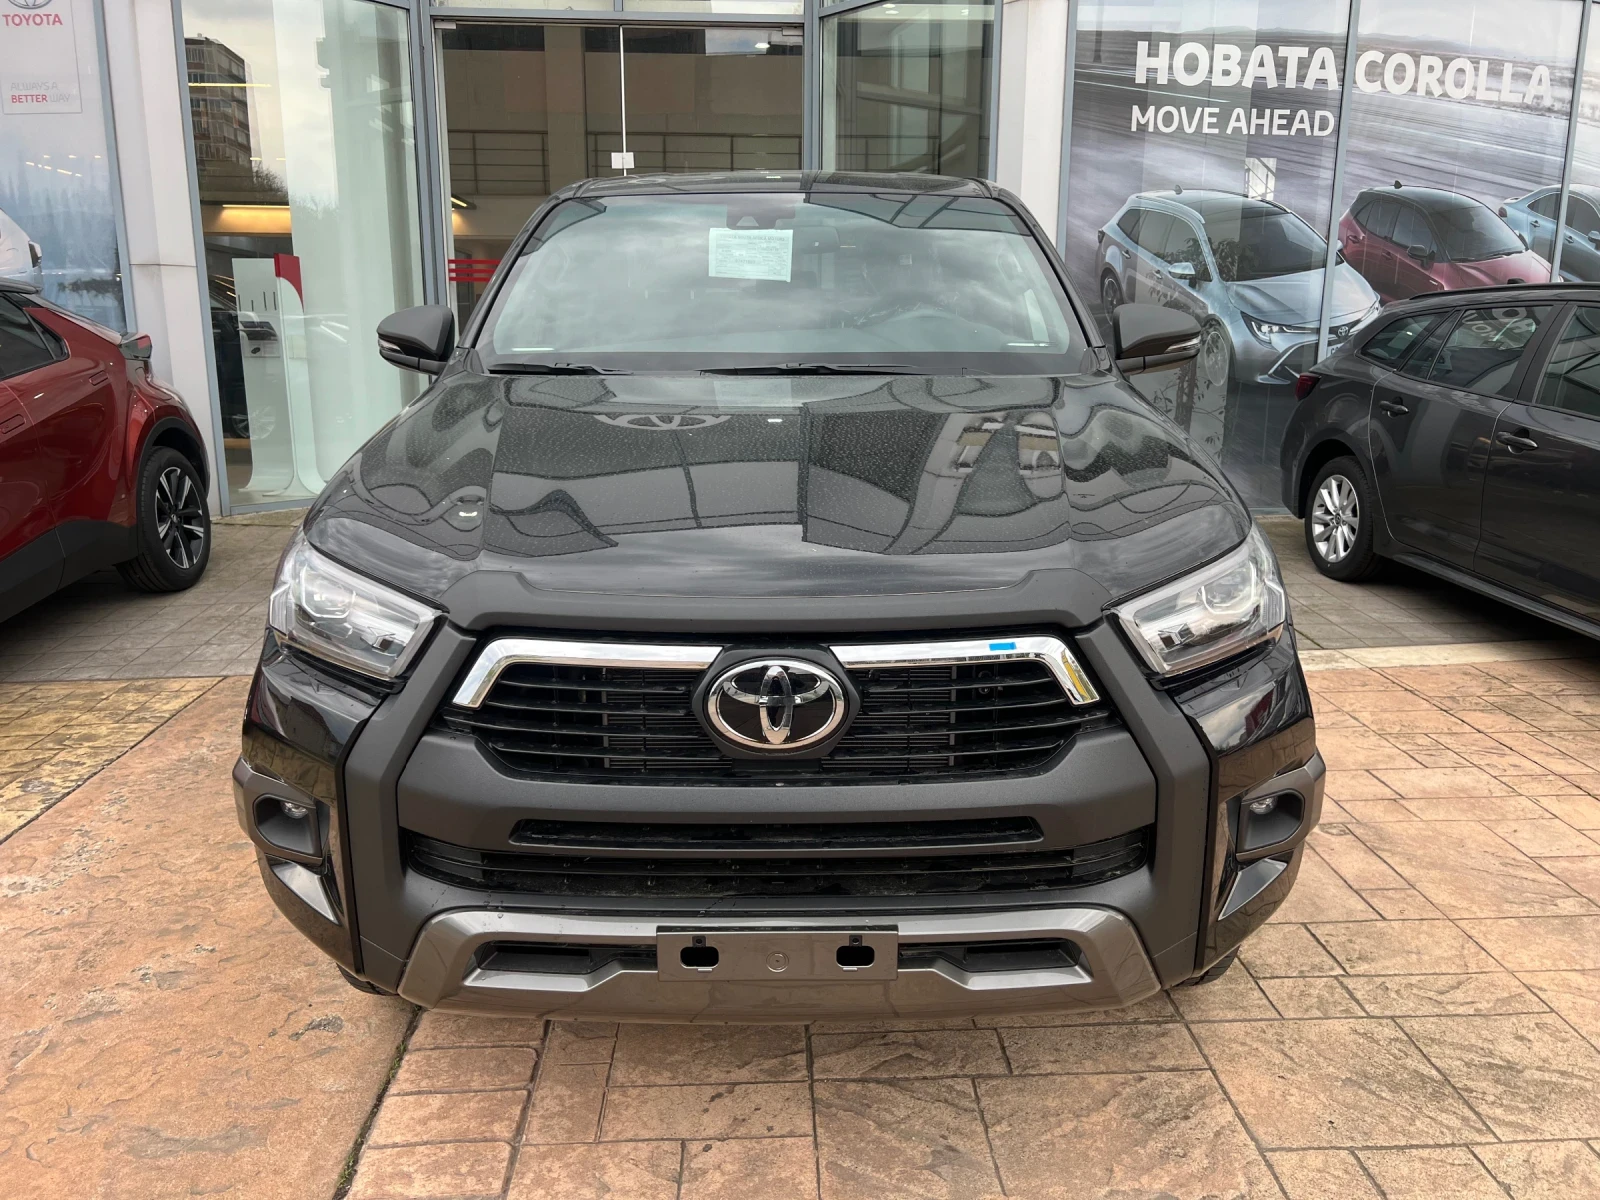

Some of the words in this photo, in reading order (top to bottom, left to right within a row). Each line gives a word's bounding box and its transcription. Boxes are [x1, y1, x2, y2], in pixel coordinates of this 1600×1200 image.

[2, 13, 63, 26] TOYOTA
[1135, 40, 1339, 91] HOBATA
[1355, 50, 1552, 106] COROLLA
[10, 82, 49, 92] ALWAYS
[51, 81, 59, 91] A
[11, 94, 48, 103] BETTER
[49, 93, 71, 103] WAY
[1130, 104, 1220, 134] MOVE
[1226, 107, 1335, 137] AHEAD
